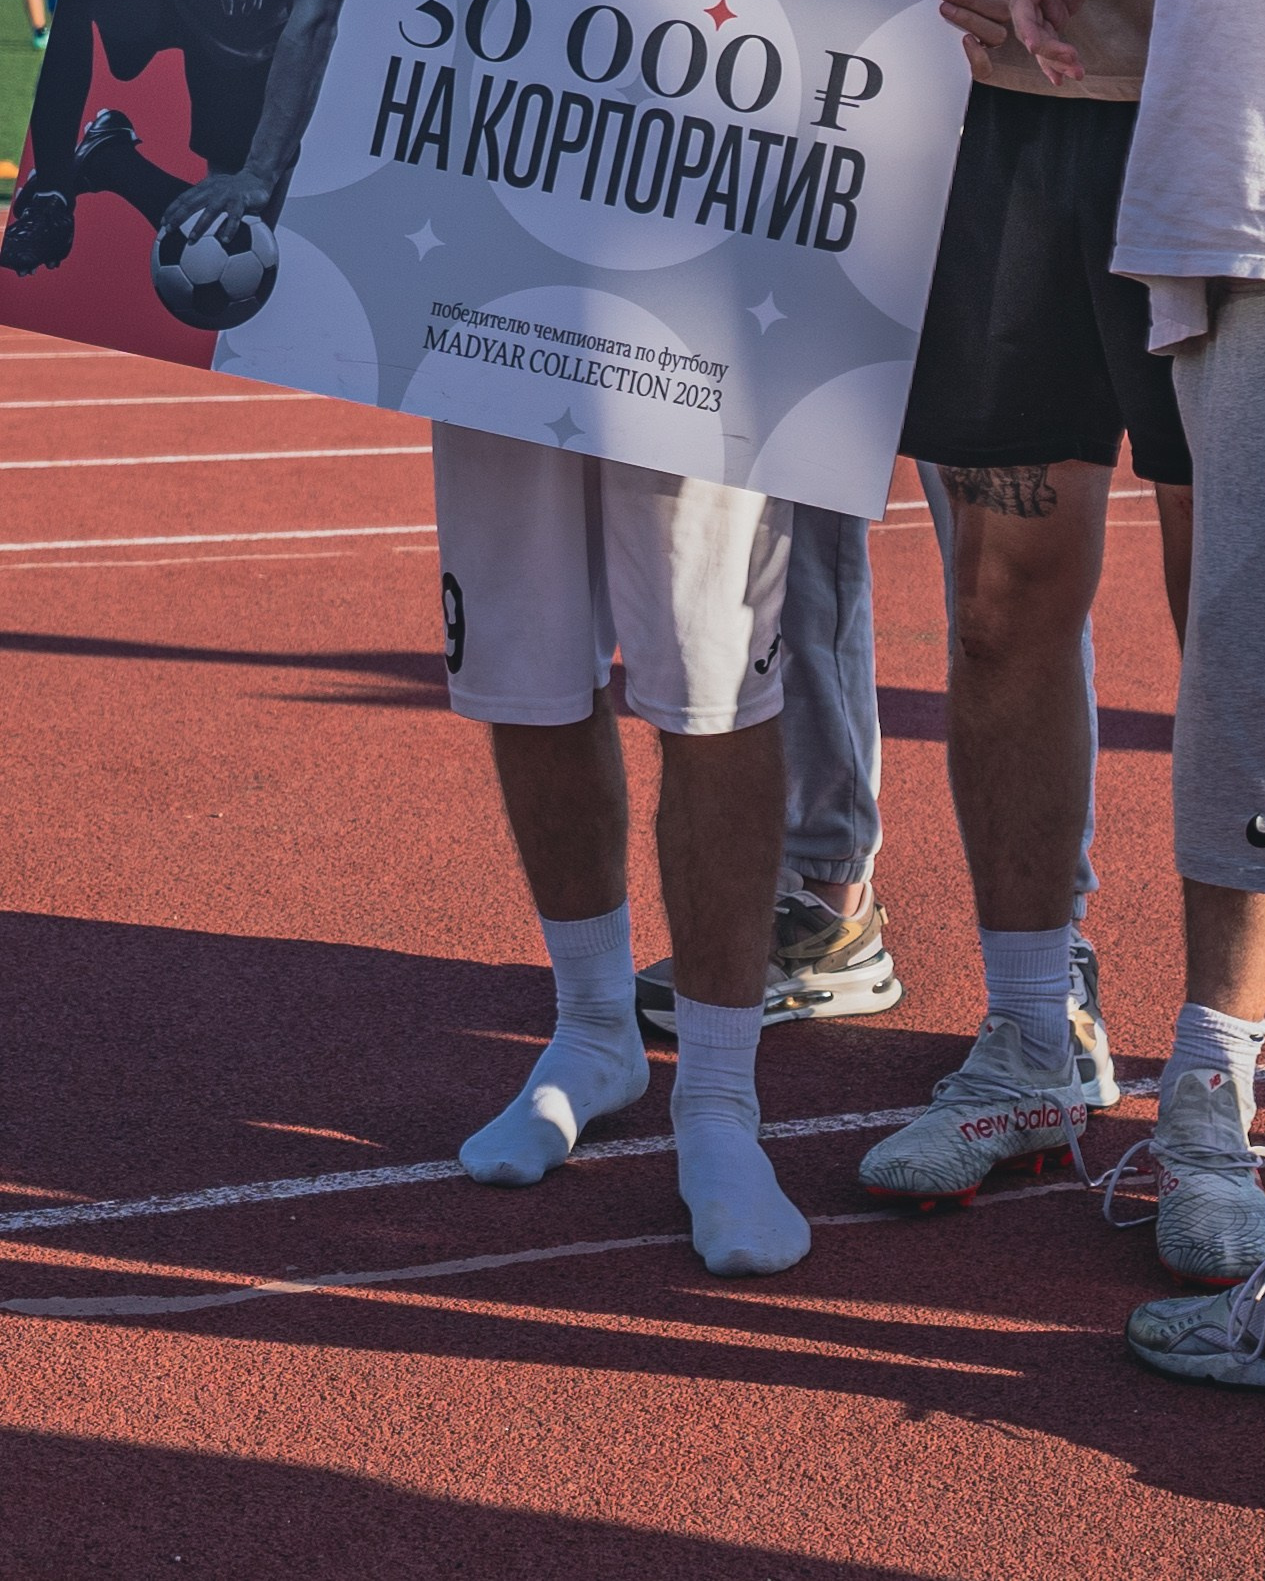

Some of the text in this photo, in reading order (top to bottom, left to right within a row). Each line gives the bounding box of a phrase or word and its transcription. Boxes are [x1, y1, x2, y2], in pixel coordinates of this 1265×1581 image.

[566, 4, 783, 113] 000
[369, 55, 866, 253] НА КОРПОРАТИВ
[422, 326, 723, 413] MADYAR COLLECTION 2023
[430, 301, 730, 383] победителю чемпионата по футболу
[960, 1114, 1009, 1142] new
